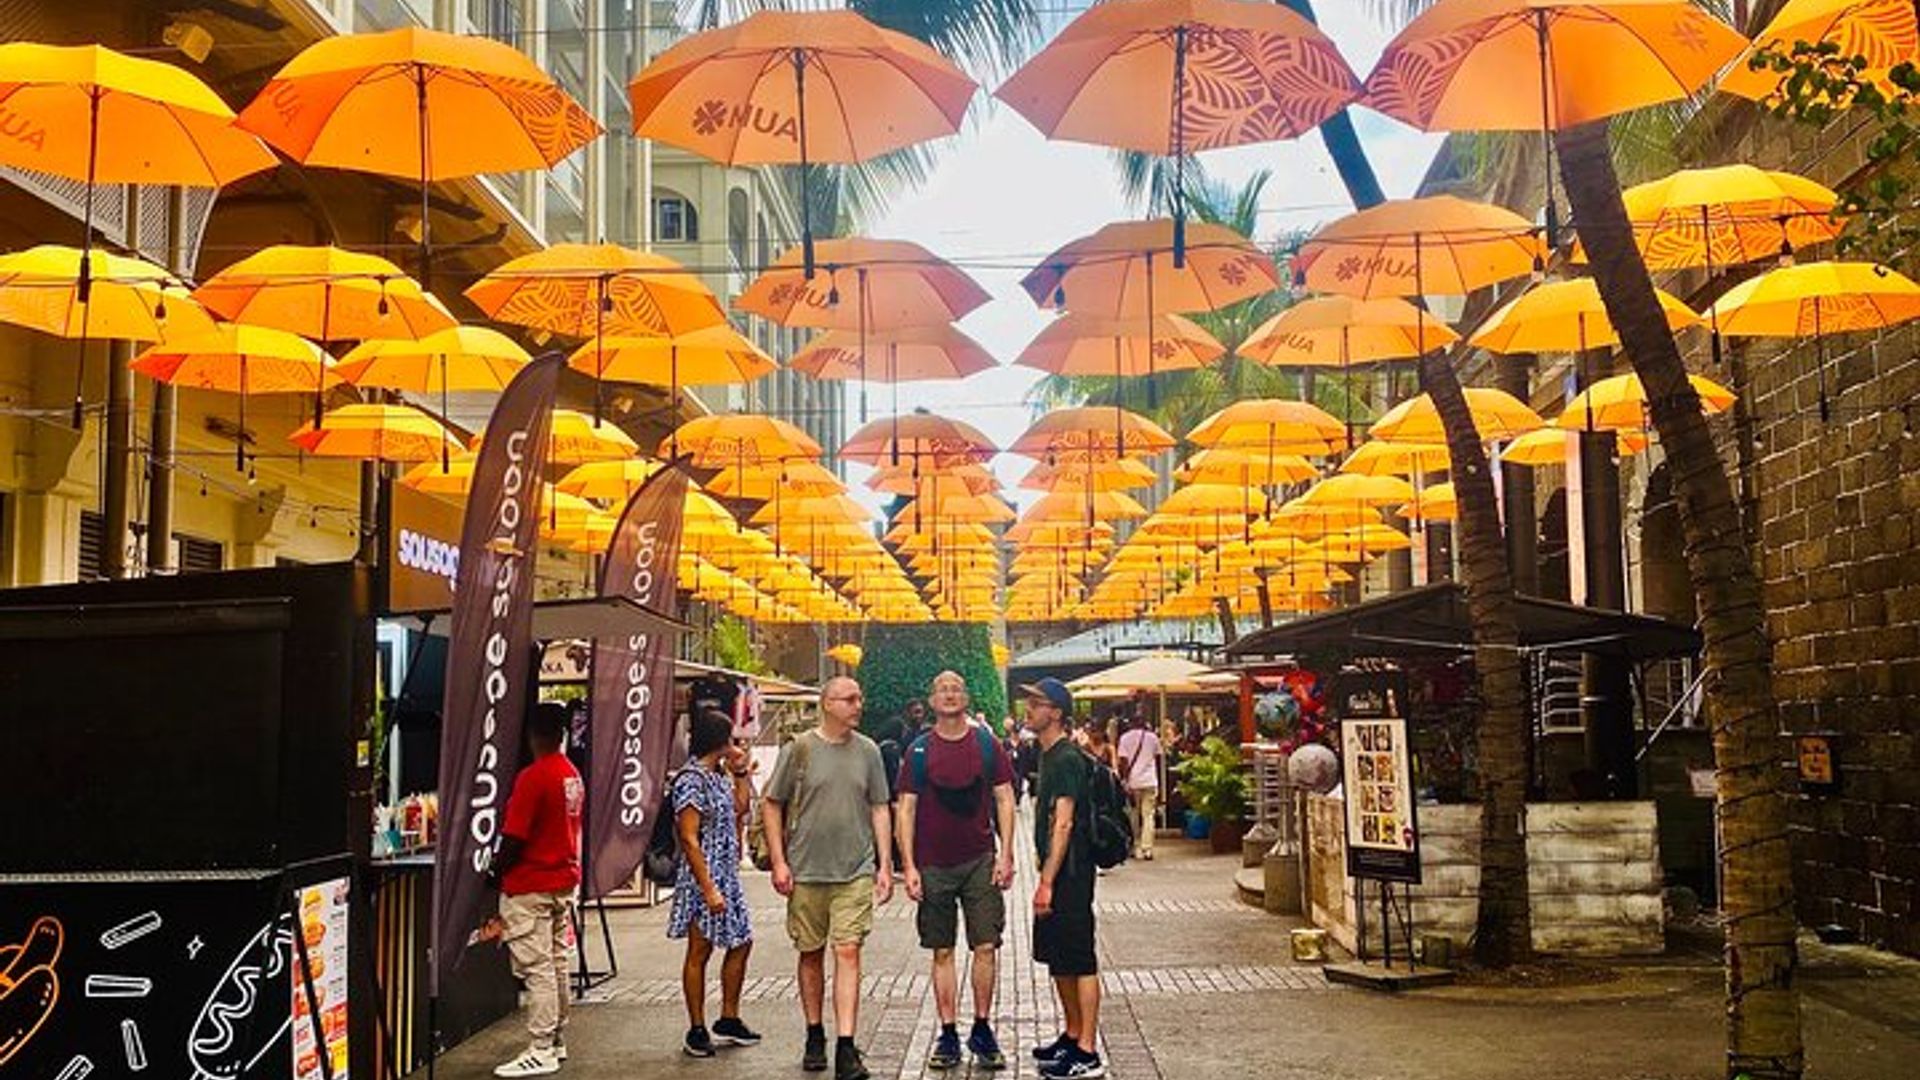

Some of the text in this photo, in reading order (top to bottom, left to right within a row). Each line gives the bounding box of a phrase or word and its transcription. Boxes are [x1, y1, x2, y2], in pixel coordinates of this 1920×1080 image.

[0, 107, 47, 152] UA
[728, 104, 799, 144] MUA
[795, 285, 839, 309] MU
[620, 520, 658, 826] sausage sloon
